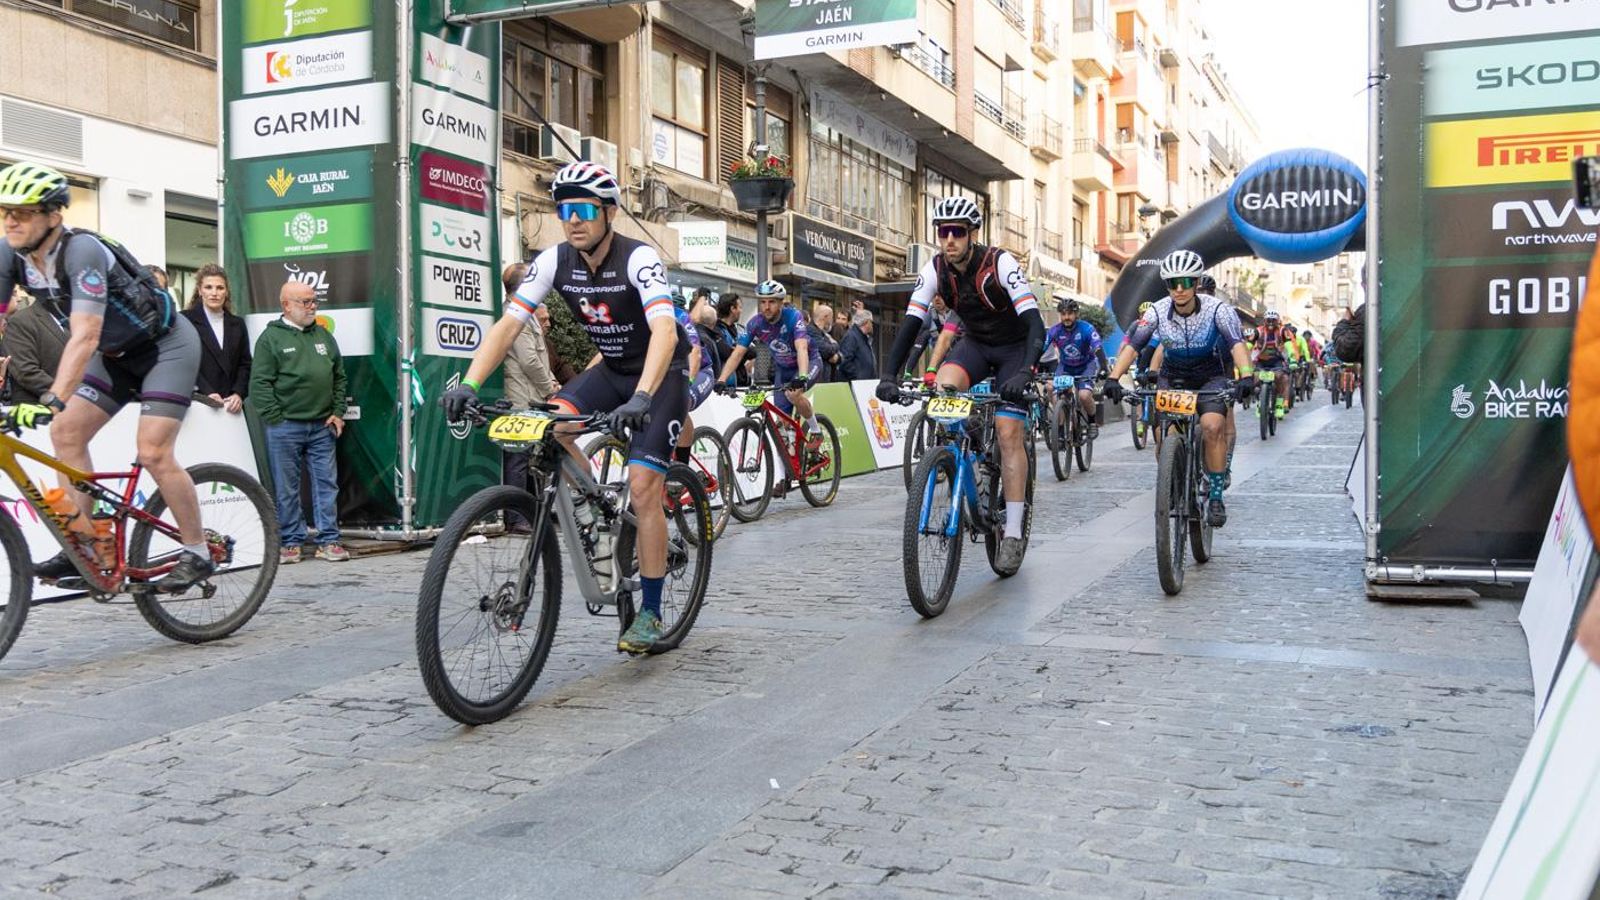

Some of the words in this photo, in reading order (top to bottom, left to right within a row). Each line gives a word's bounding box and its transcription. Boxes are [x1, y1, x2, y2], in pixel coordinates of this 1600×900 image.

[815, 5, 853, 25] JAÉN
[805, 32, 863, 48] GARMIN
[296, 50, 345, 66] Diputación
[295, 67, 306, 77] de
[254, 104, 361, 137] GARMIN
[422, 108, 487, 142] GARMIN
[297, 172, 318, 184] CAJA
[319, 169, 350, 182] RURAL
[442, 168, 484, 192] IMDECO
[312, 181, 335, 194] JAÉN
[1241, 187, 1354, 211] GARMIN
[683, 236, 720, 245] TECNOCASA
[805, 228, 841, 255] VERÓNICA
[848, 243, 865, 261] JESÚS
[1504, 232, 1597, 246] northwave
[433, 264, 481, 287] POWER
[455, 284, 481, 302] ADE
[562, 284, 628, 294] MONDRAKER
[439, 323, 476, 346] CRUZ
[582, 323, 635, 335] rimaflor
[931, 399, 969, 413] 235-2
[1160, 391, 1195, 411] 512-2
[1484, 401, 1531, 418] BIKE
[494, 416, 545, 435] 235-1
